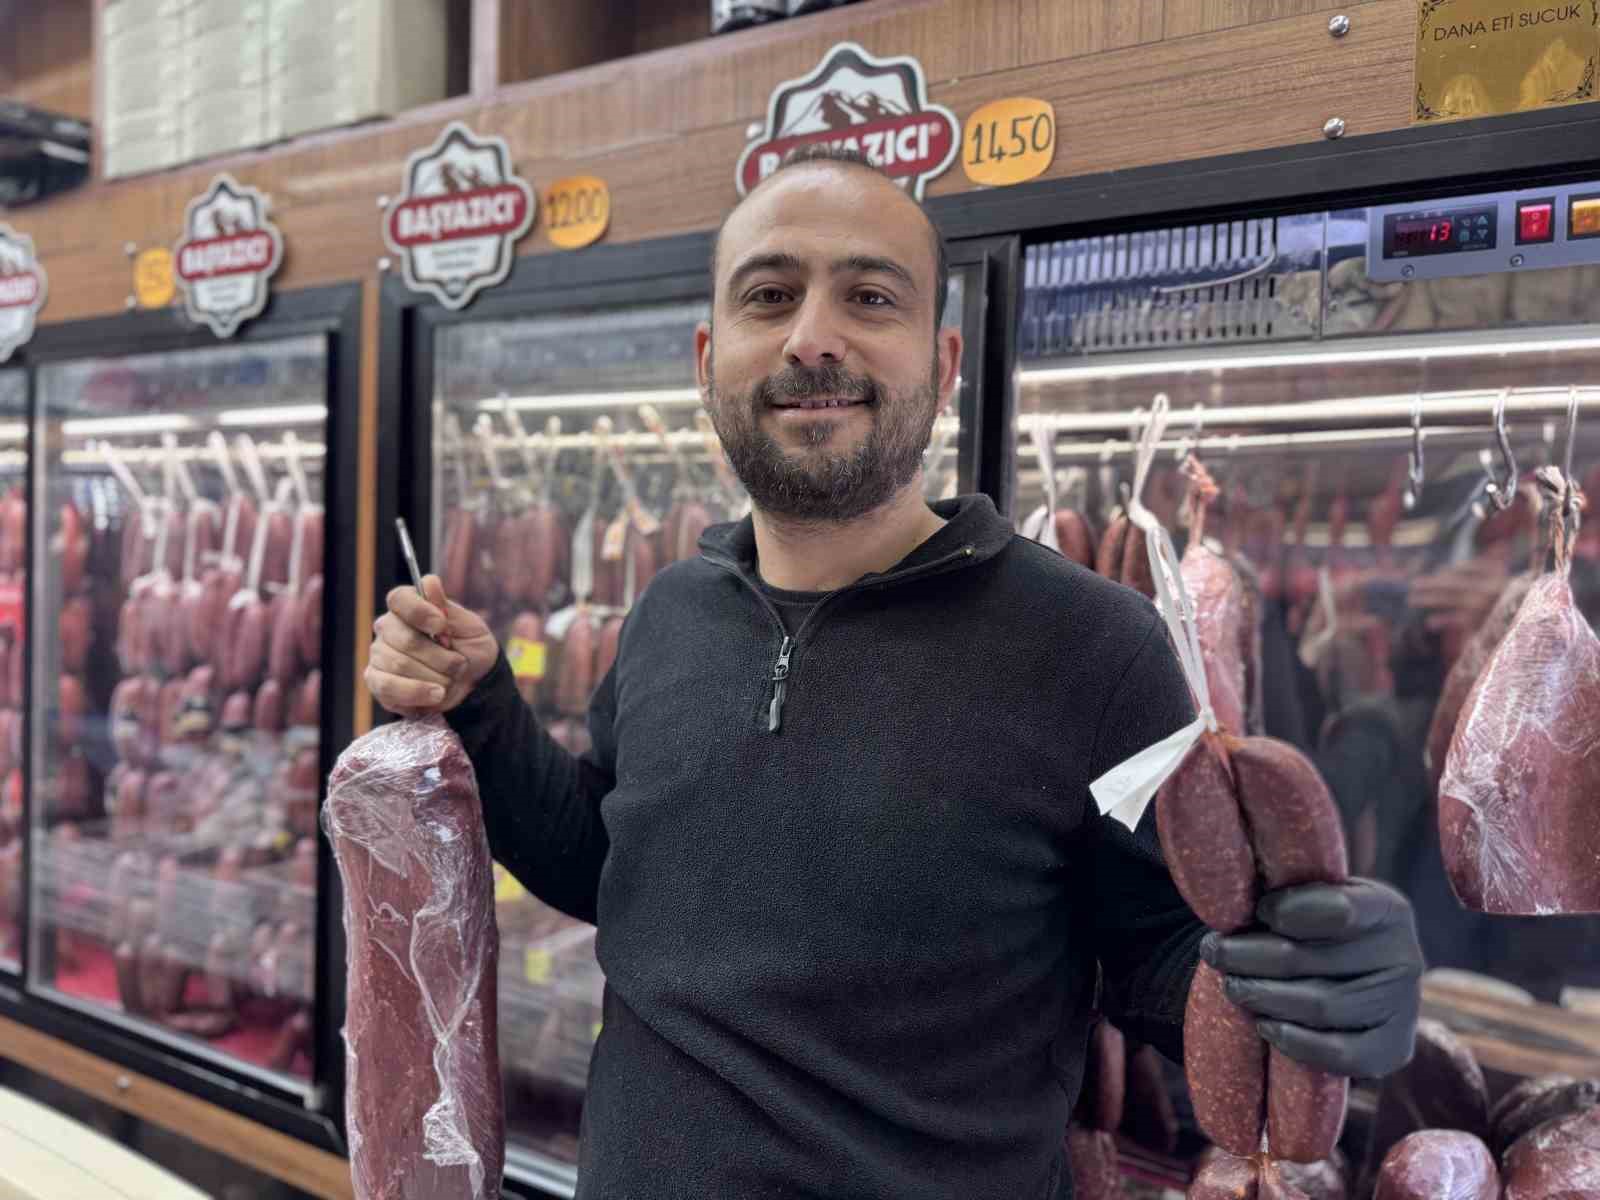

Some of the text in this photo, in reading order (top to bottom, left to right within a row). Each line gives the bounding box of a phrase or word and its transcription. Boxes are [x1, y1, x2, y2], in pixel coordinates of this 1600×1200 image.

[1433, 3, 1581, 41] DANA ETİ SUCUK
[967, 112, 1051, 165] 1450
[1429, 221, 1452, 241] 13
